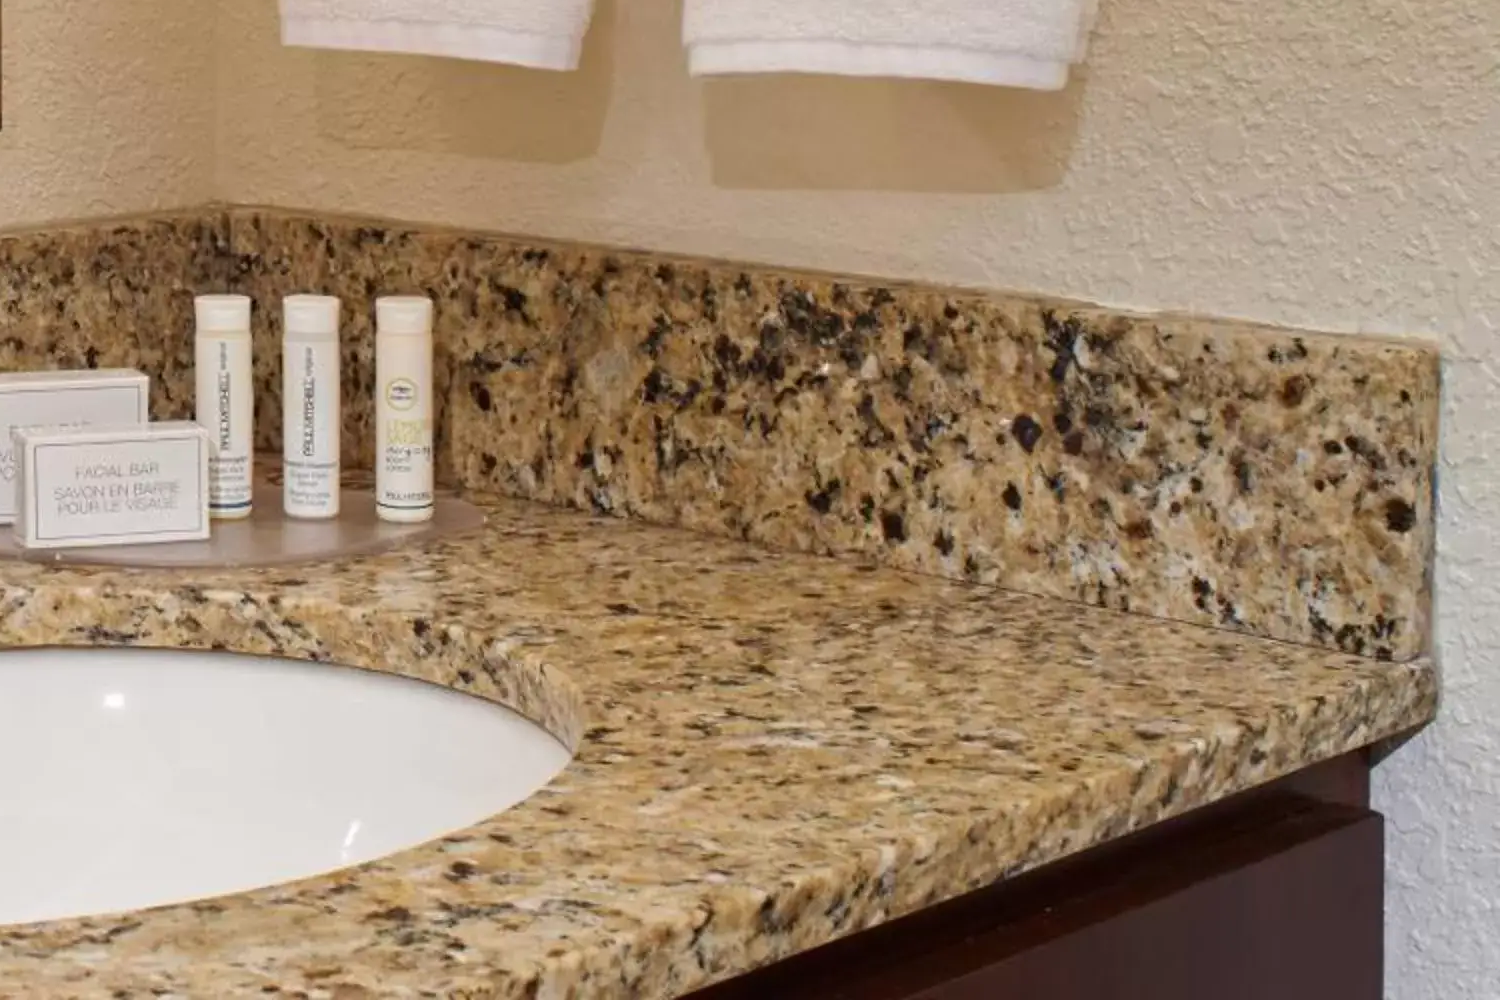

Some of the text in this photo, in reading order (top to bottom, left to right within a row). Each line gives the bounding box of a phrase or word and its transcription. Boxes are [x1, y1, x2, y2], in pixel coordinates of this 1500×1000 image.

[75, 461, 160, 479] FACIAL BAR
[54, 485, 105, 500] SAVON
[109, 484, 129, 498] EN
[58, 500, 99, 516] POUR
[104, 501, 120, 513] LE
